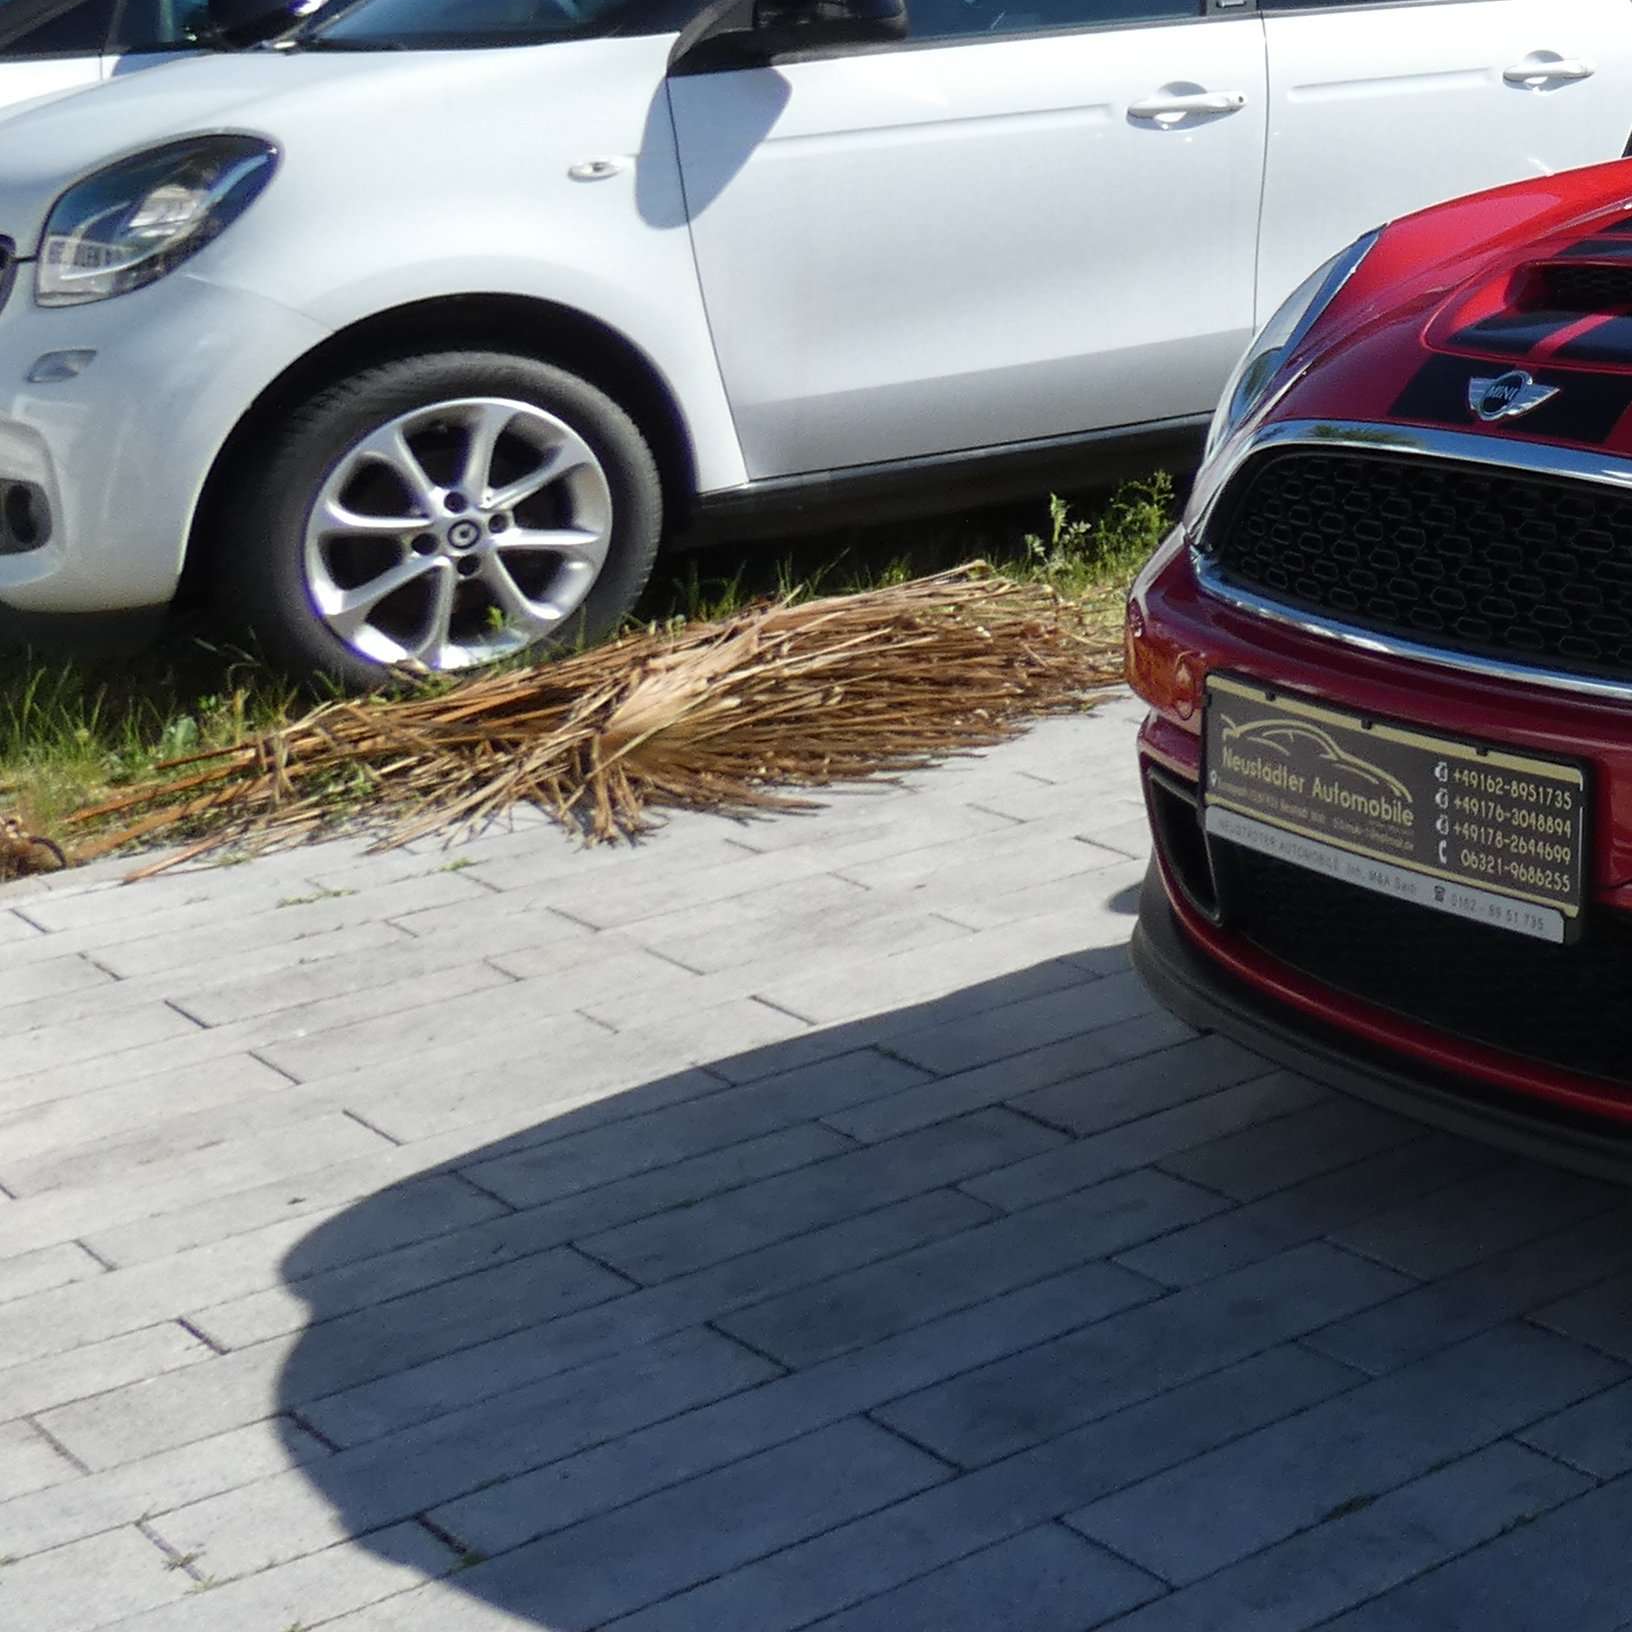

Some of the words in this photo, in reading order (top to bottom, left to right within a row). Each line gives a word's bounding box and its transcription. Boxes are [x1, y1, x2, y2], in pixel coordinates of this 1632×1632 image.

[1486, 385, 1519, 401] MINI
[1312, 776, 1415, 826] Automobile
[1460, 849, 1571, 893] 06321-9686255
